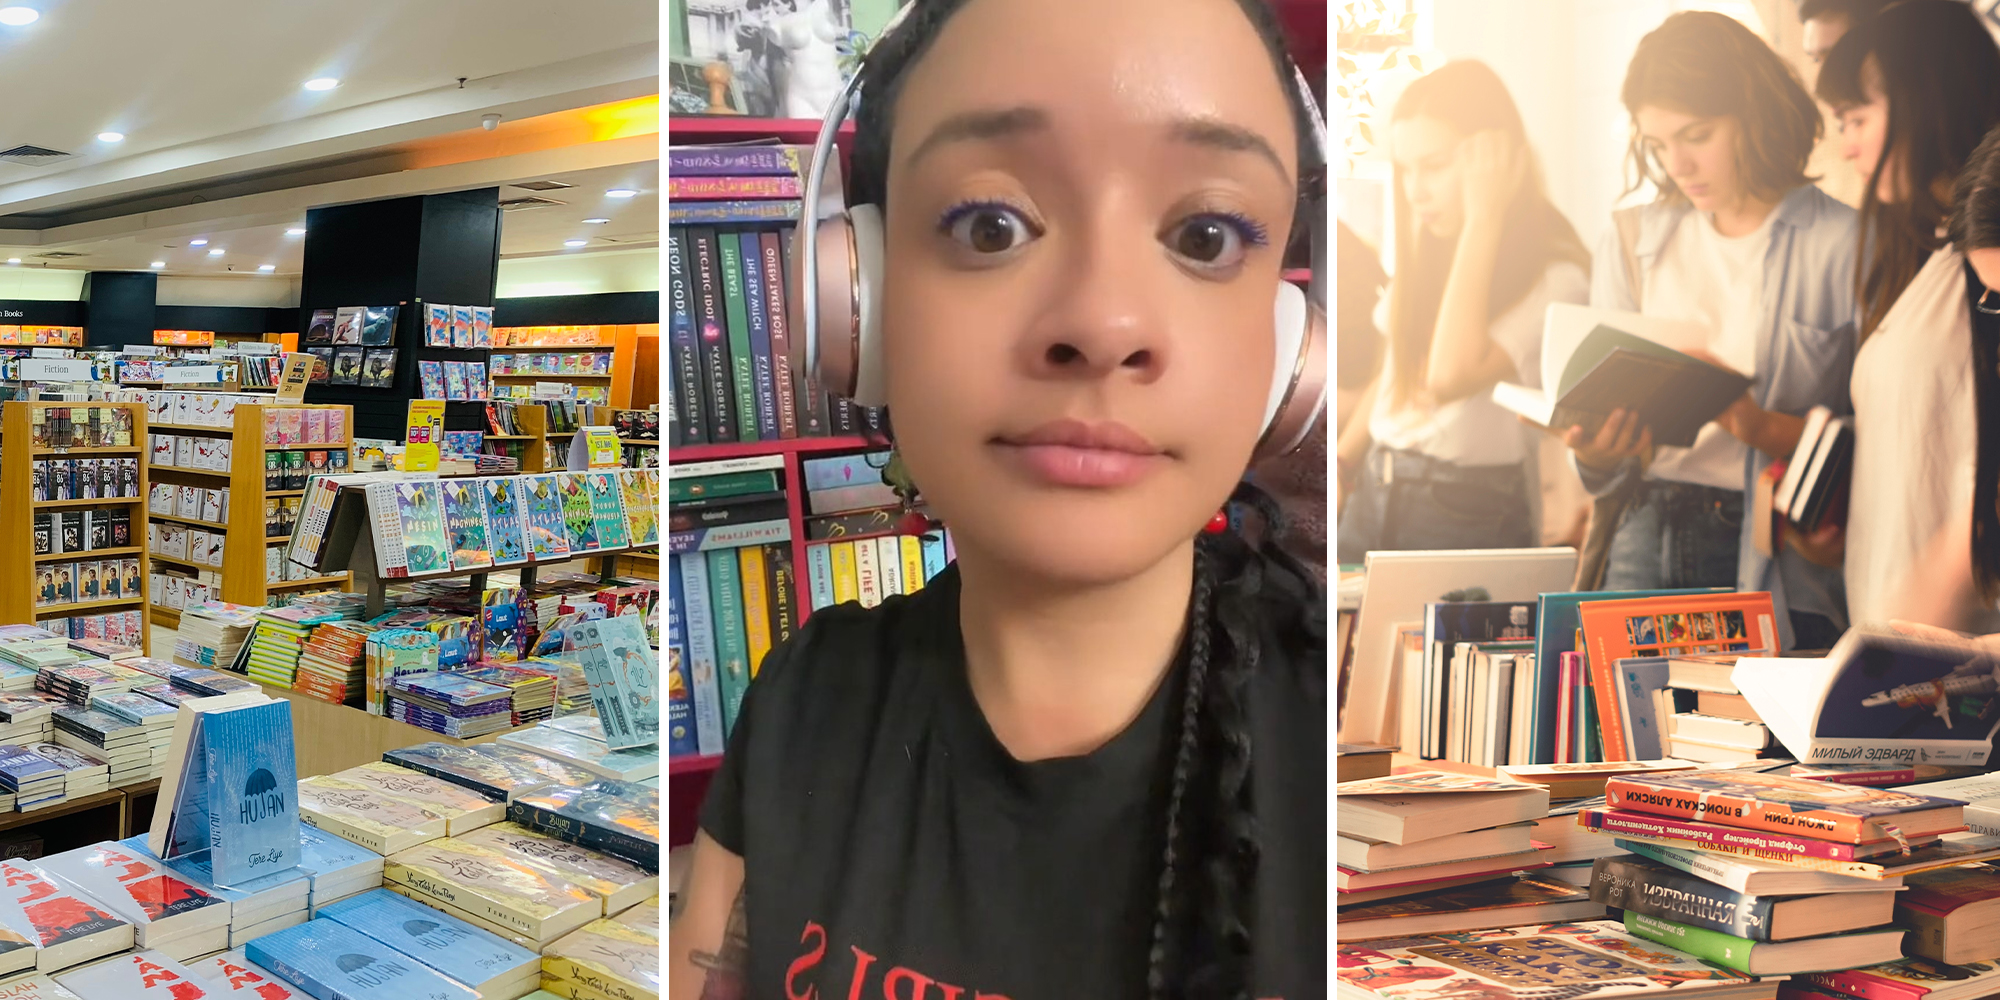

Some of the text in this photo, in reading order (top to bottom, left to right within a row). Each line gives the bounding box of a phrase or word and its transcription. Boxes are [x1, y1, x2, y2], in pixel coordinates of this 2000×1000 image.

[44, 365, 69, 374] Fiction
[180, 370, 200, 378] Fiction
[104, 473, 110, 482] 86
[124, 472, 131, 481] 86
[406, 519, 438, 533] MESIN
[492, 516, 520, 530] ATLAS
[531, 512, 561, 526] ATLAS
[496, 614, 508, 622] Laut
[445, 649, 457, 657] Laut
[1812, 746, 1916, 761] МИЛЫЙ ЭДВАРД
[240, 792, 285, 825] HUJAN
[1626, 791, 1742, 817] В ПОИСКАХ АЛЯСКИ
[1606, 817, 1664, 834] Хотценплотц
[1765, 812, 1837, 831] ДЖОН ГРИН
[210, 812, 222, 848] HUJAN
[1666, 826, 1713, 841] Разбойник
[1723, 833, 1805, 853] Отфрид Пройслер
[1697, 839, 1793, 863] СОБАКИ И ЩЕНКИ
[249, 852, 266, 868] Tere
[1599, 871, 1636, 889] ВЕРОНИКА
[1609, 887, 1623, 899] РОТ
[169, 902, 189, 911] TERE
[1644, 883, 1736, 925] ИЗБРАННАЯ
[487, 906, 508, 920] TERE
[65, 921, 105, 935] TERE LIYE
[416, 926, 472, 950] HUJAN
[273, 959, 289, 976] Tere
[347, 961, 409, 989] HUJAN
